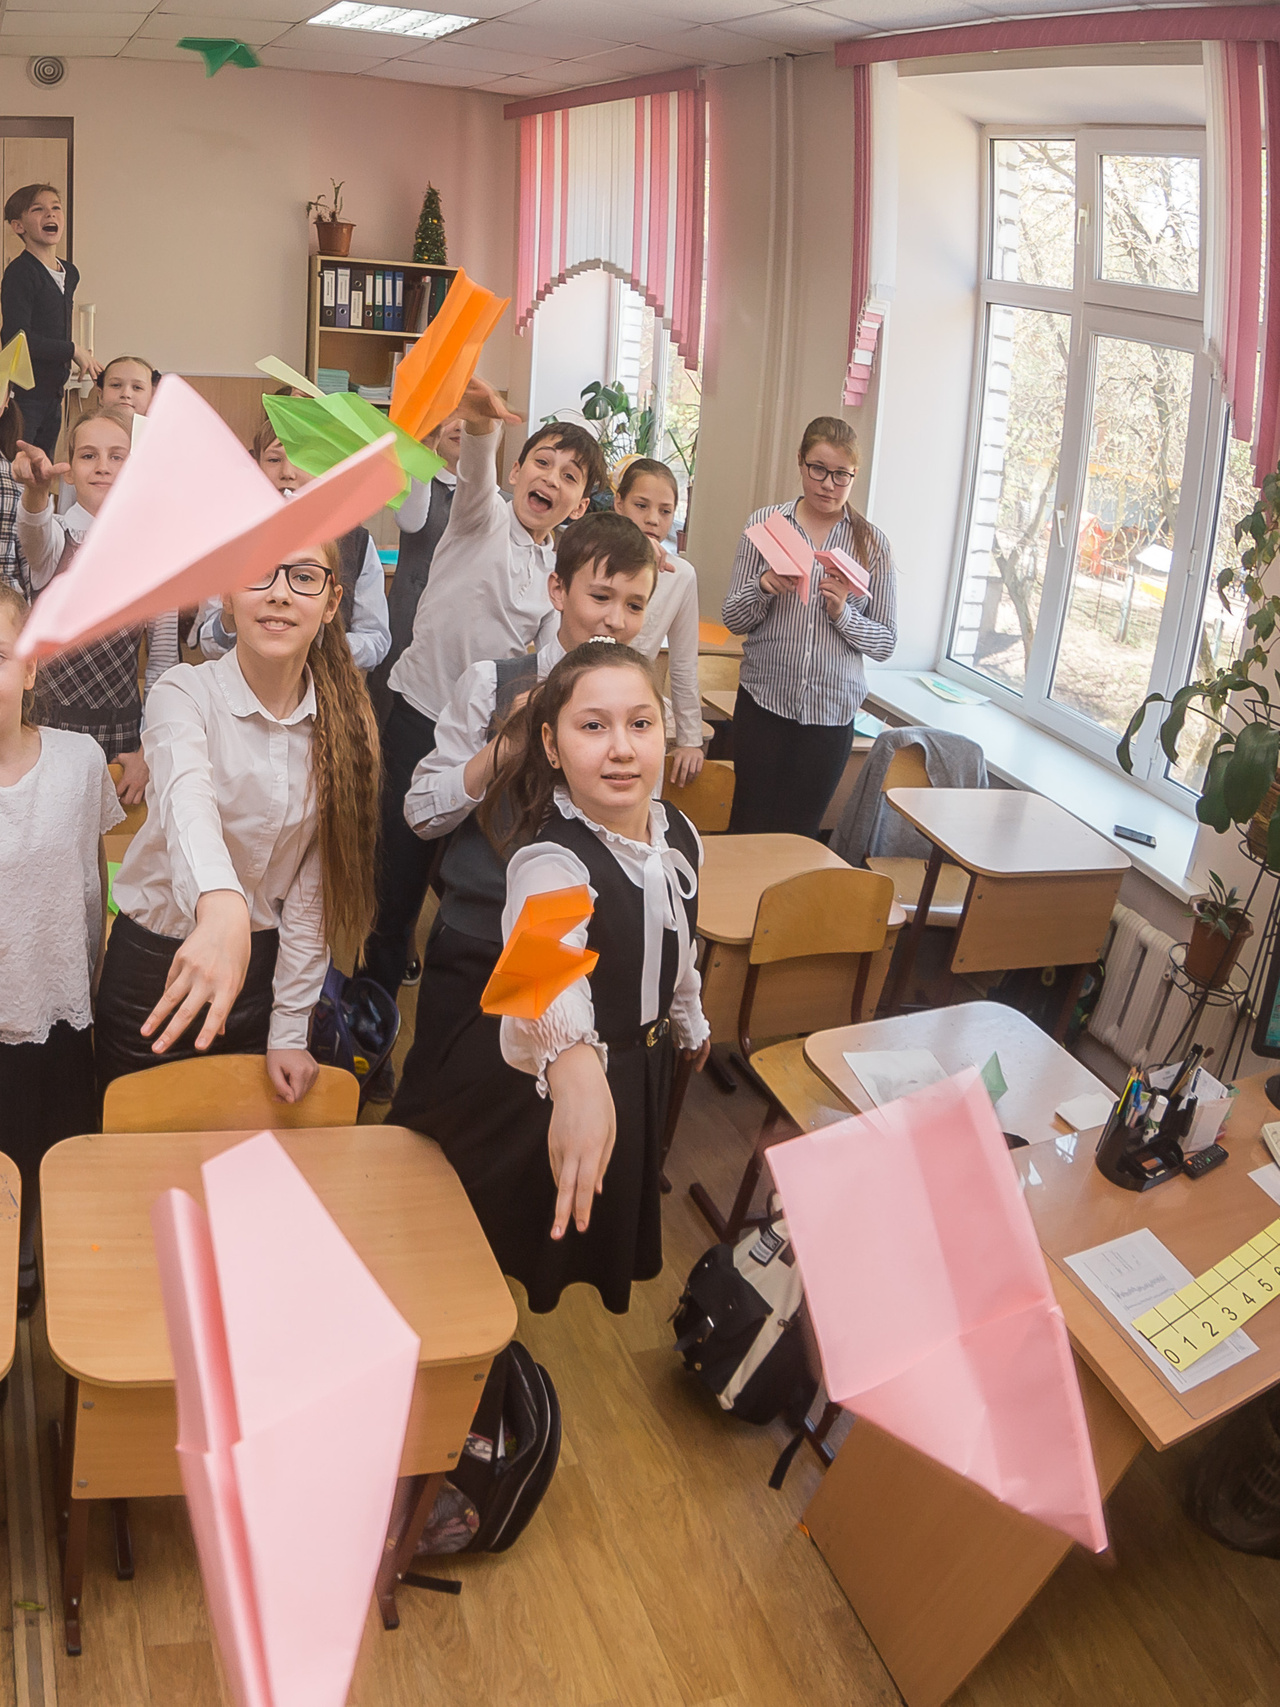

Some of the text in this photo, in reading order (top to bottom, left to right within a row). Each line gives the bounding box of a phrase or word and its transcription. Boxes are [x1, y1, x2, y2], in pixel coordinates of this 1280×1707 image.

[1164, 1278, 1273, 1364] 0 1 2 3 4 5
